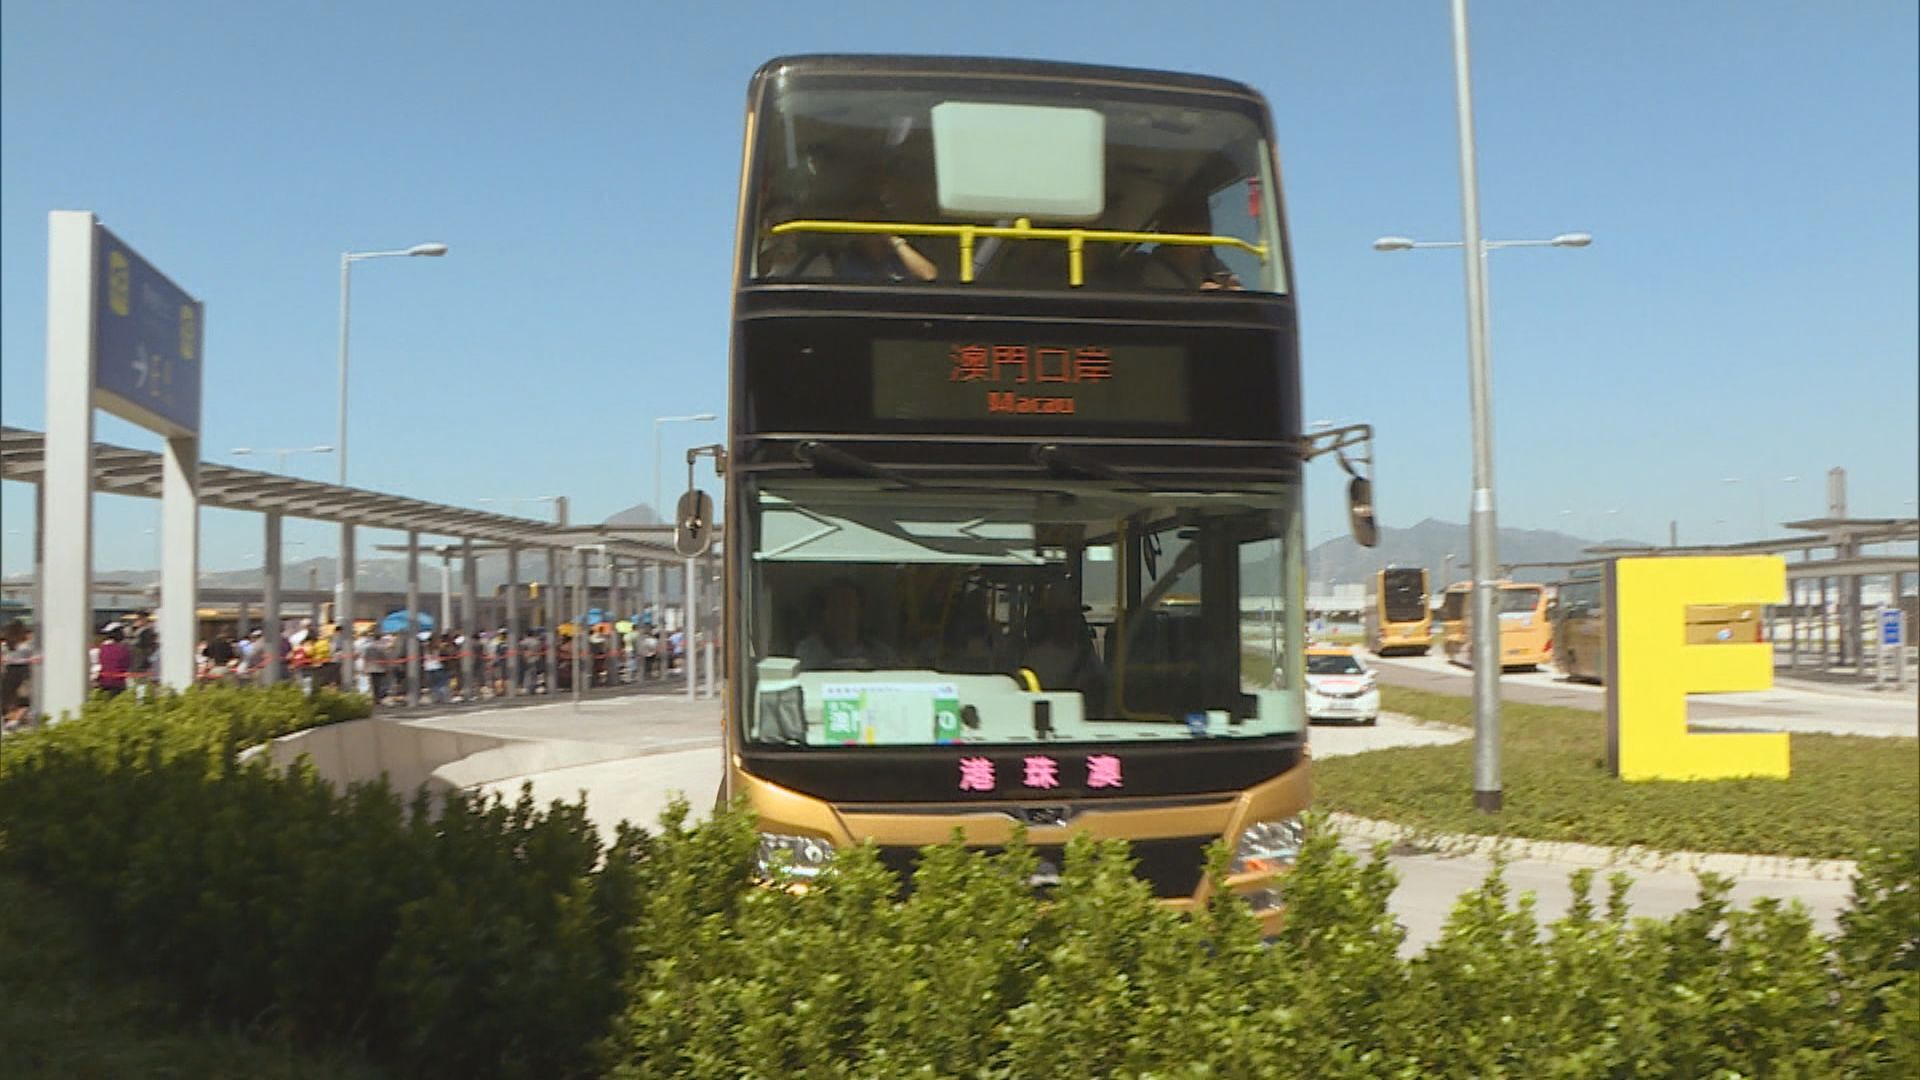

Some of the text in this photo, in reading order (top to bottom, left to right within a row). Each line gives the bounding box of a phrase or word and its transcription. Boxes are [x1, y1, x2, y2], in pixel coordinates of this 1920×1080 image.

[949, 344, 1113, 384] 澳門口岸
[987, 391, 1076, 414] Macau
[1615, 554, 1791, 782] E
[959, 754, 1124, 791] 港珠澳
